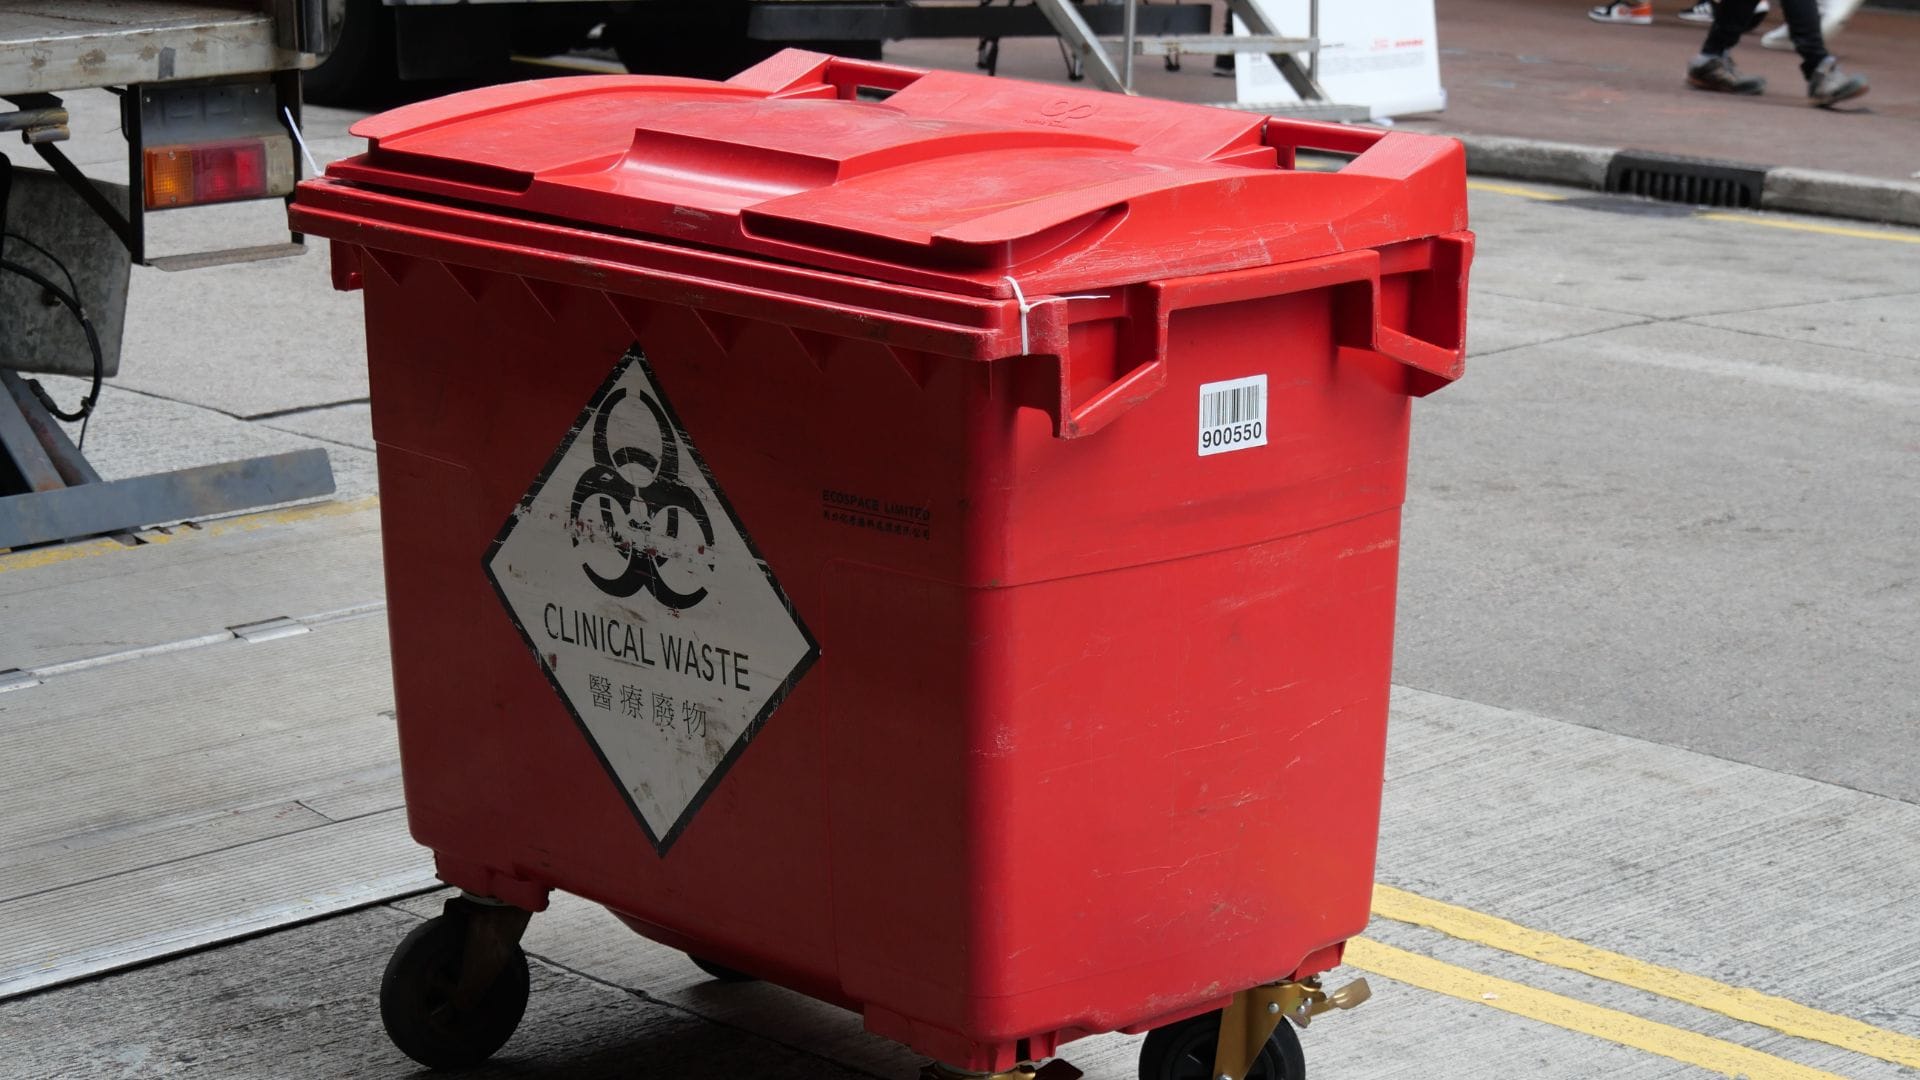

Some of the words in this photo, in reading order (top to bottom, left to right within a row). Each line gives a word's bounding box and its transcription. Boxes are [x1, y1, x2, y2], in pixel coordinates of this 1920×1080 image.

[1202, 421, 1262, 449] 900550
[823, 490, 879, 509] ECOSPACE
[885, 502, 930, 521] LIMITED
[544, 602, 655, 665] CLINICAL
[660, 632, 750, 691] WASTE
[588, 673, 708, 739] 醫療廢物
